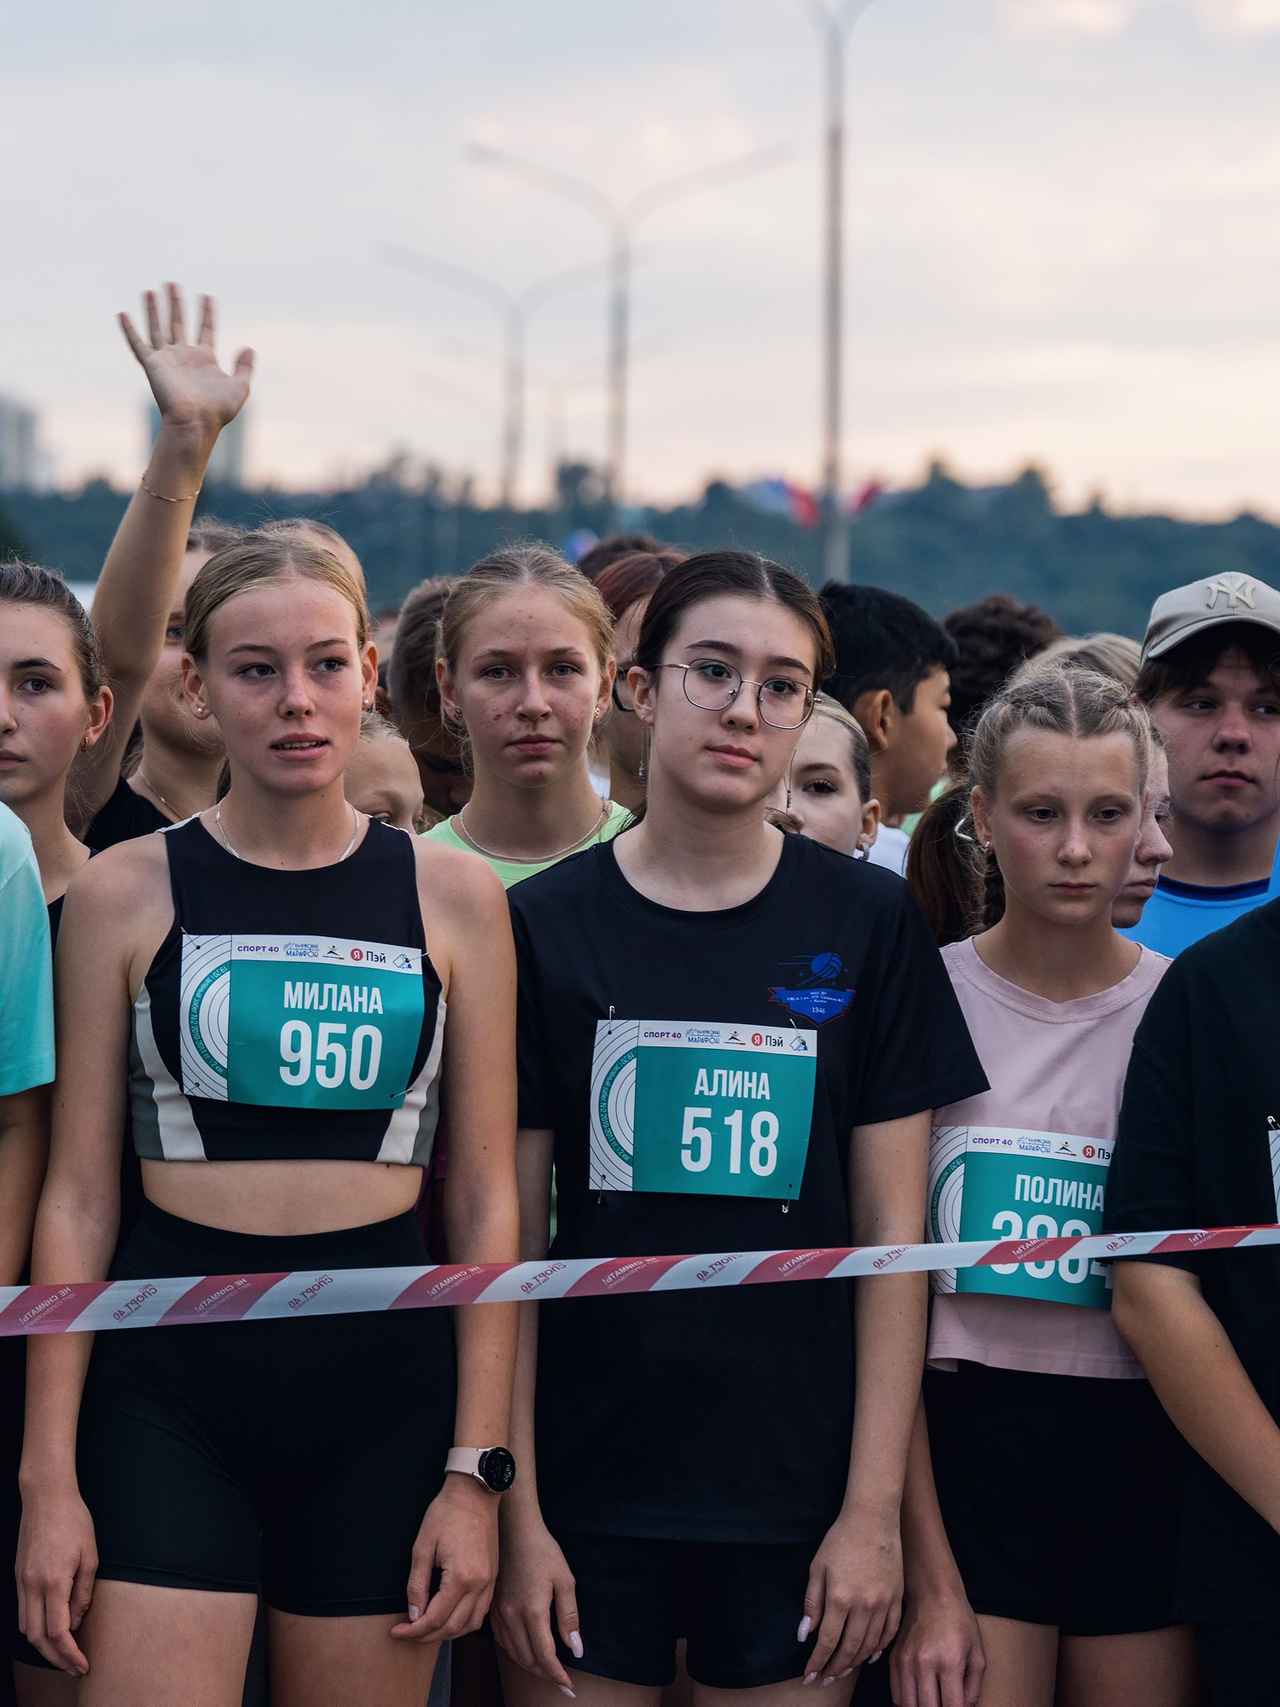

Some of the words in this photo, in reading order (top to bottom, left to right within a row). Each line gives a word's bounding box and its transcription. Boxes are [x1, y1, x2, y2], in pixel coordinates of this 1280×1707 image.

[366, 951, 386, 964] Пэй
[283, 981, 384, 1015] МИЛАНА
[644, 1031, 671, 1039] СПОРТ
[765, 1035, 784, 1048] Пэй
[279, 1019, 383, 1090] 950
[694, 1068, 770, 1100] АЛИНА
[680, 1106, 780, 1177] 518
[972, 1137, 1001, 1145] СПОРТ
[1097, 1148, 1112, 1161] Пэ
[1015, 1174, 1105, 1212] ПОЛИНА
